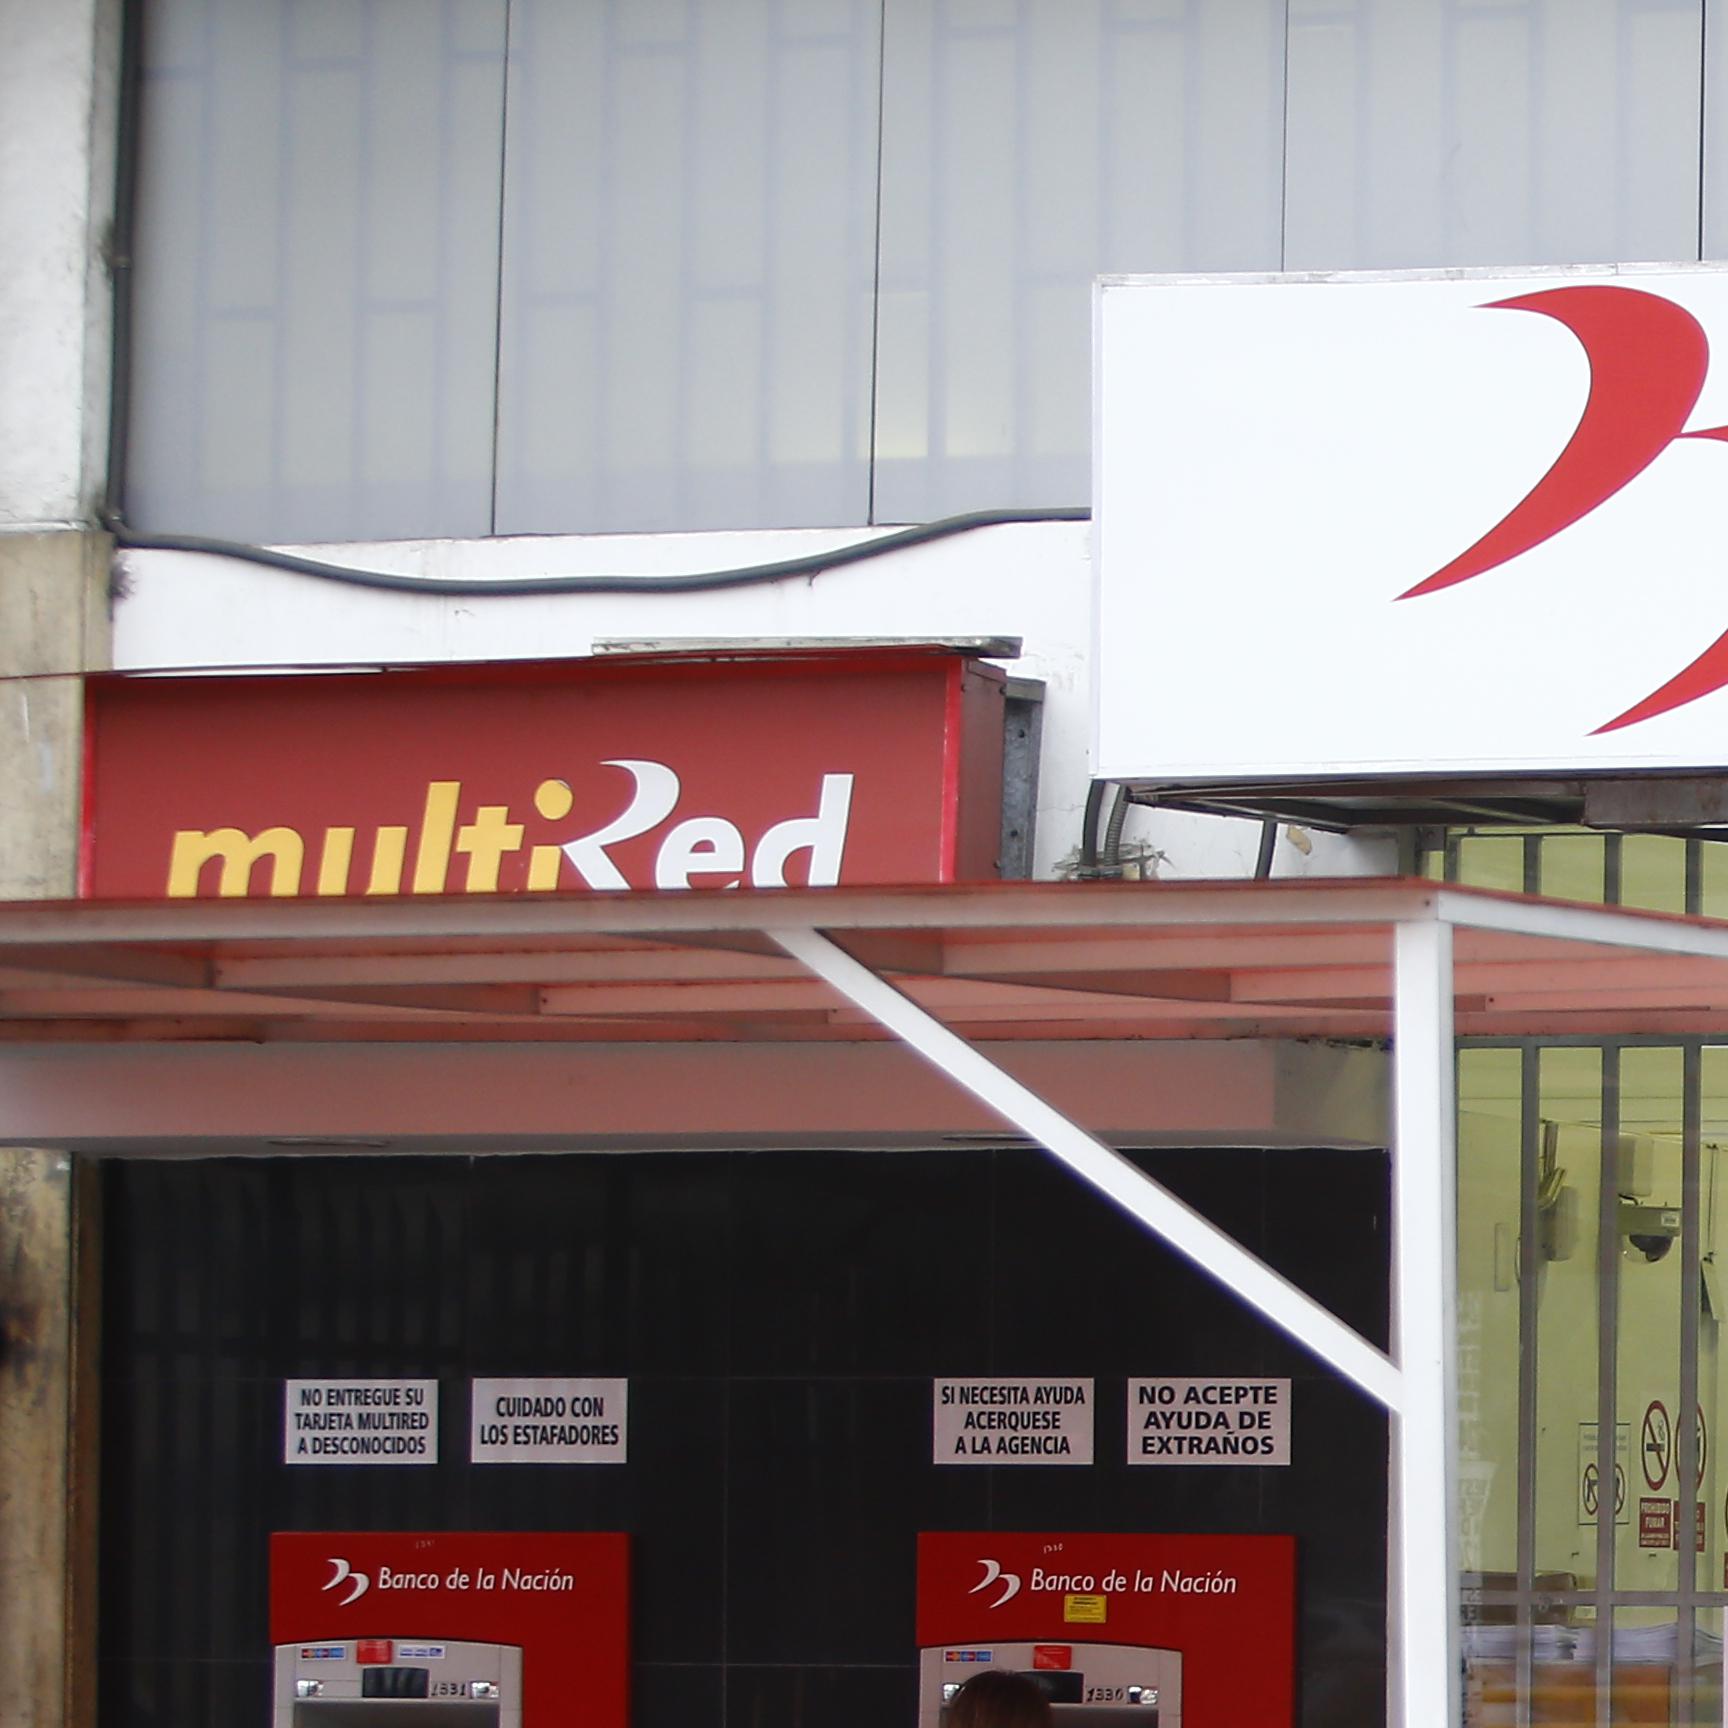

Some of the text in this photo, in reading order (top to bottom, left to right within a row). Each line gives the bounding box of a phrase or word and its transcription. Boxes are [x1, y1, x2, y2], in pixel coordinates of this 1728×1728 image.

[301, 1387, 424, 1407] NO ENTREGUE SU
[941, 1385, 1086, 1405] SI NECESITA AYUDA
[1138, 1385, 1278, 1405] NO ACEPTE
[495, 1396, 604, 1418] CUIDADO CON
[294, 1411, 429, 1431] TARJETA MULTIRED
[963, 1410, 1061, 1433] ACERQUESE
[1143, 1410, 1271, 1430] AYUDA DE
[297, 1435, 426, 1455] A DESCONOCIDOS
[480, 1424, 619, 1446] LOS ESTAFADORES
[954, 1435, 1071, 1455] A LA AGENCIA
[1141, 1427, 1274, 1455] EXTRAÑOS
[378, 1566, 574, 1591] Banco de la Nación
[1030, 1567, 1236, 1594] Banco de la Nación
